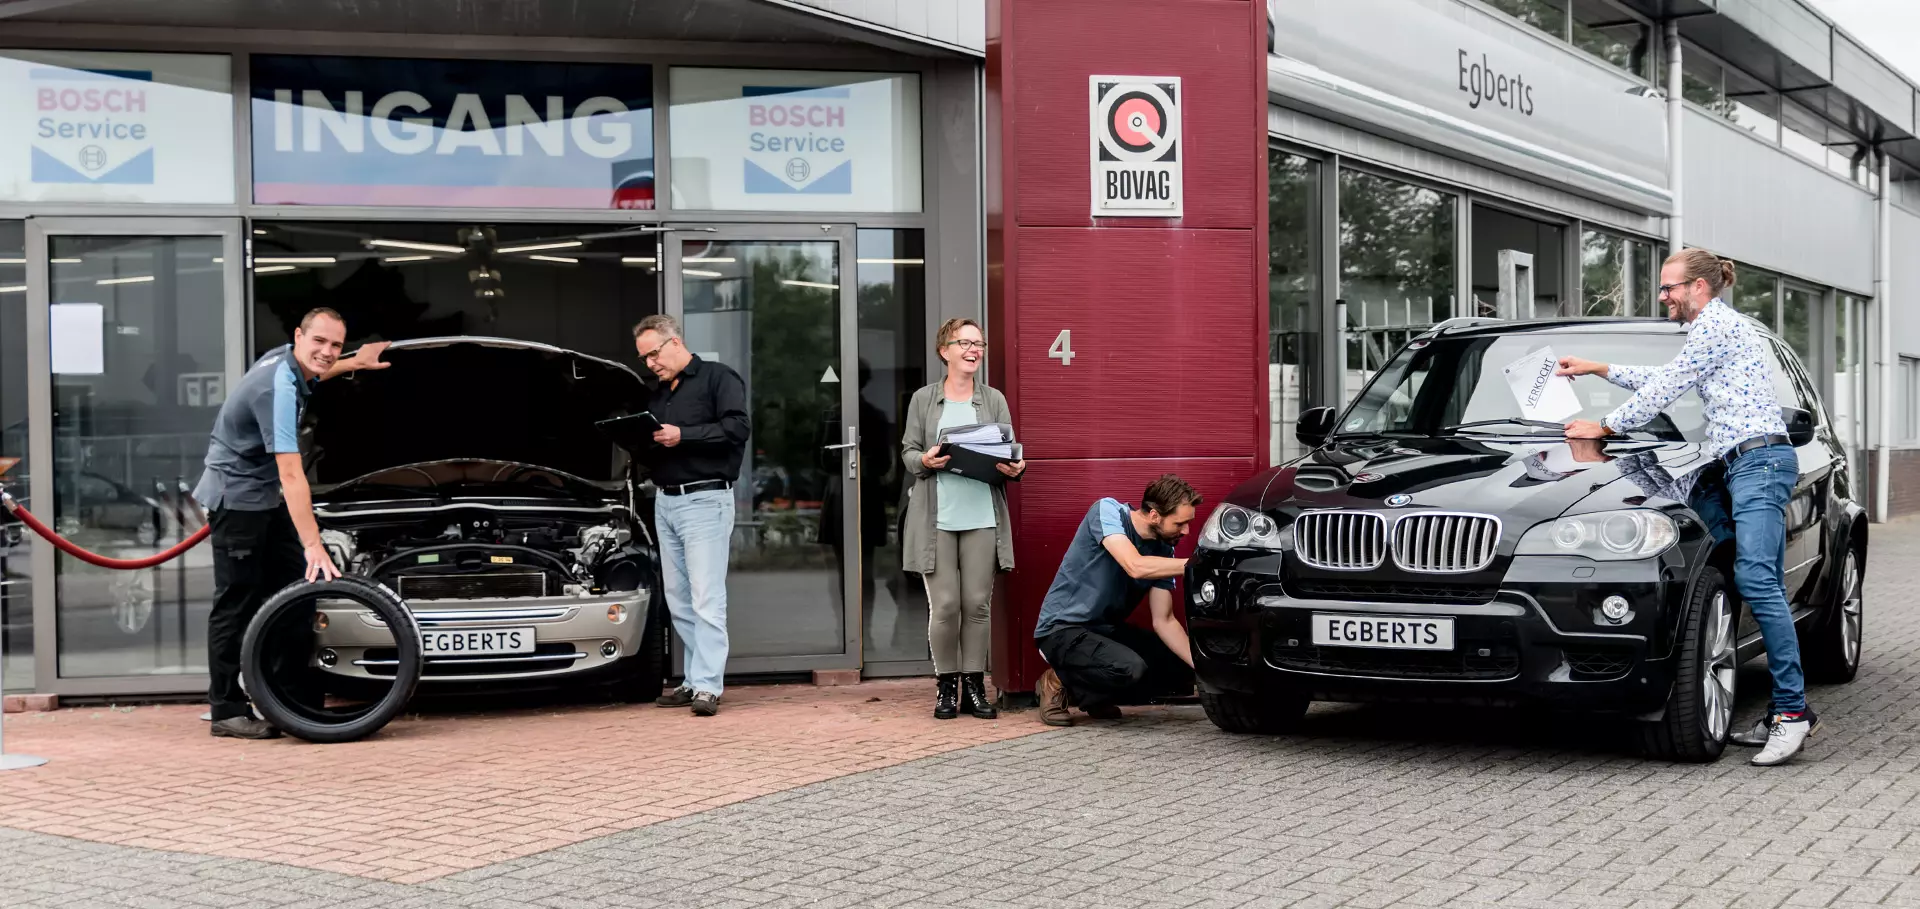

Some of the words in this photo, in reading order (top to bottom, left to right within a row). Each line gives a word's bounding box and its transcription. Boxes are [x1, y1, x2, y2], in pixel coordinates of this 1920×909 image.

[1458, 48, 1534, 116] Egberts
[37, 87, 146, 113] BOSCH
[38, 117, 146, 140] Service
[274, 89, 633, 159] INGANG
[749, 104, 845, 128] BOSCH
[750, 131, 845, 153] Service
[1106, 170, 1170, 200] BOVAG
[1048, 329, 1076, 366] 4
[1525, 357, 1555, 408] VERKOCHT
[422, 631, 522, 652] EGBERTS
[1328, 619, 1438, 645] EGBERTS
